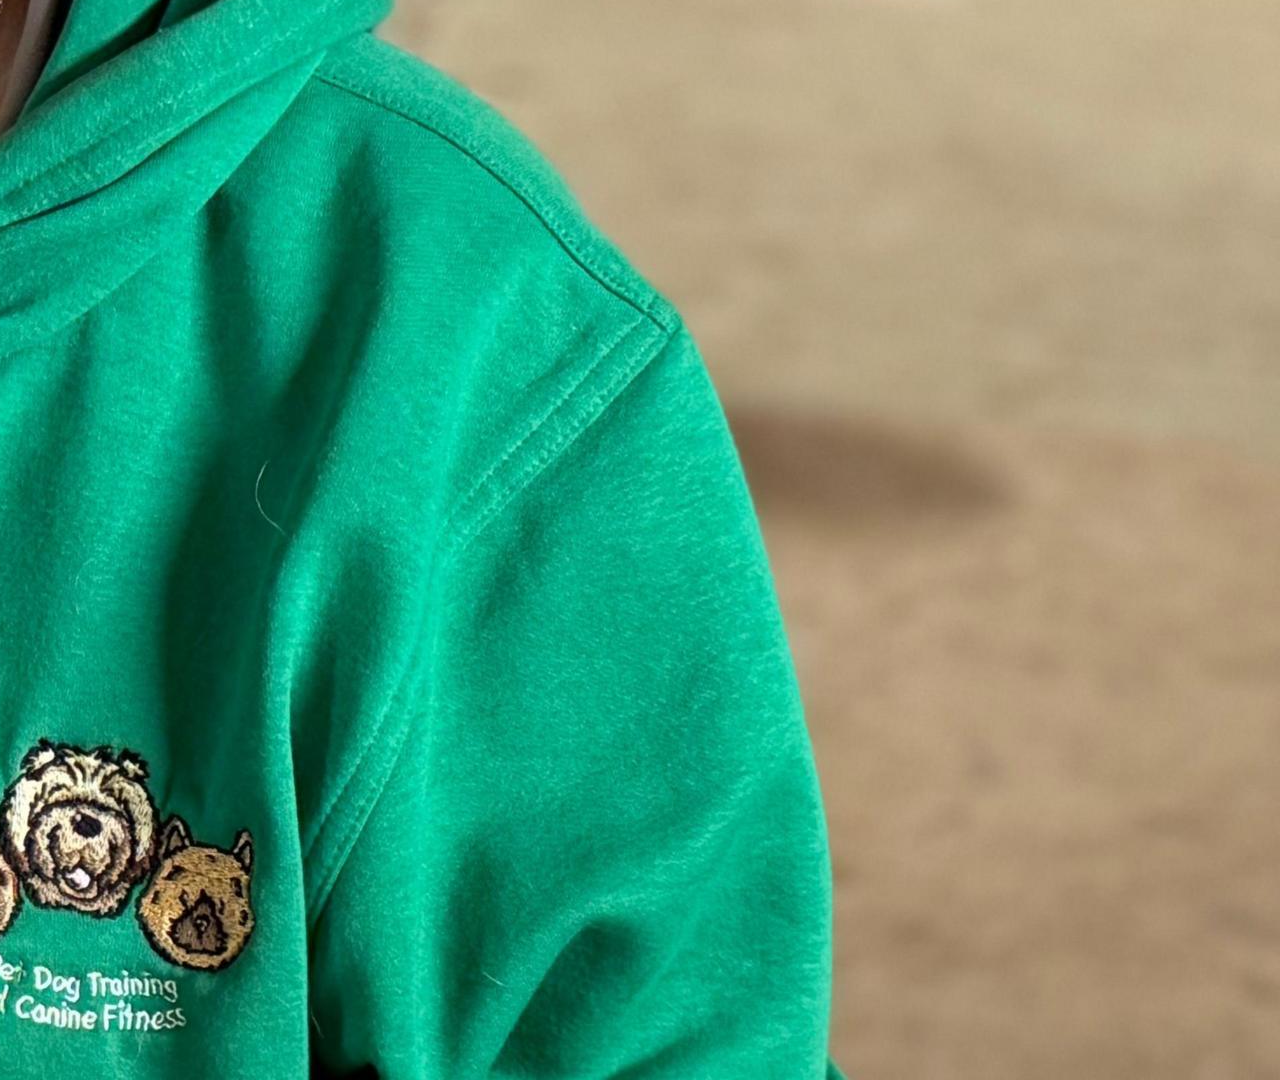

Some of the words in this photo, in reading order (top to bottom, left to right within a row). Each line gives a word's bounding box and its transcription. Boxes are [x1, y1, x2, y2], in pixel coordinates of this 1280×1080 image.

[33, 966, 80, 1003] Dog
[86, 969, 178, 1003] Training
[15, 995, 98, 1030] Canine
[103, 999, 187, 1031] Fitness
